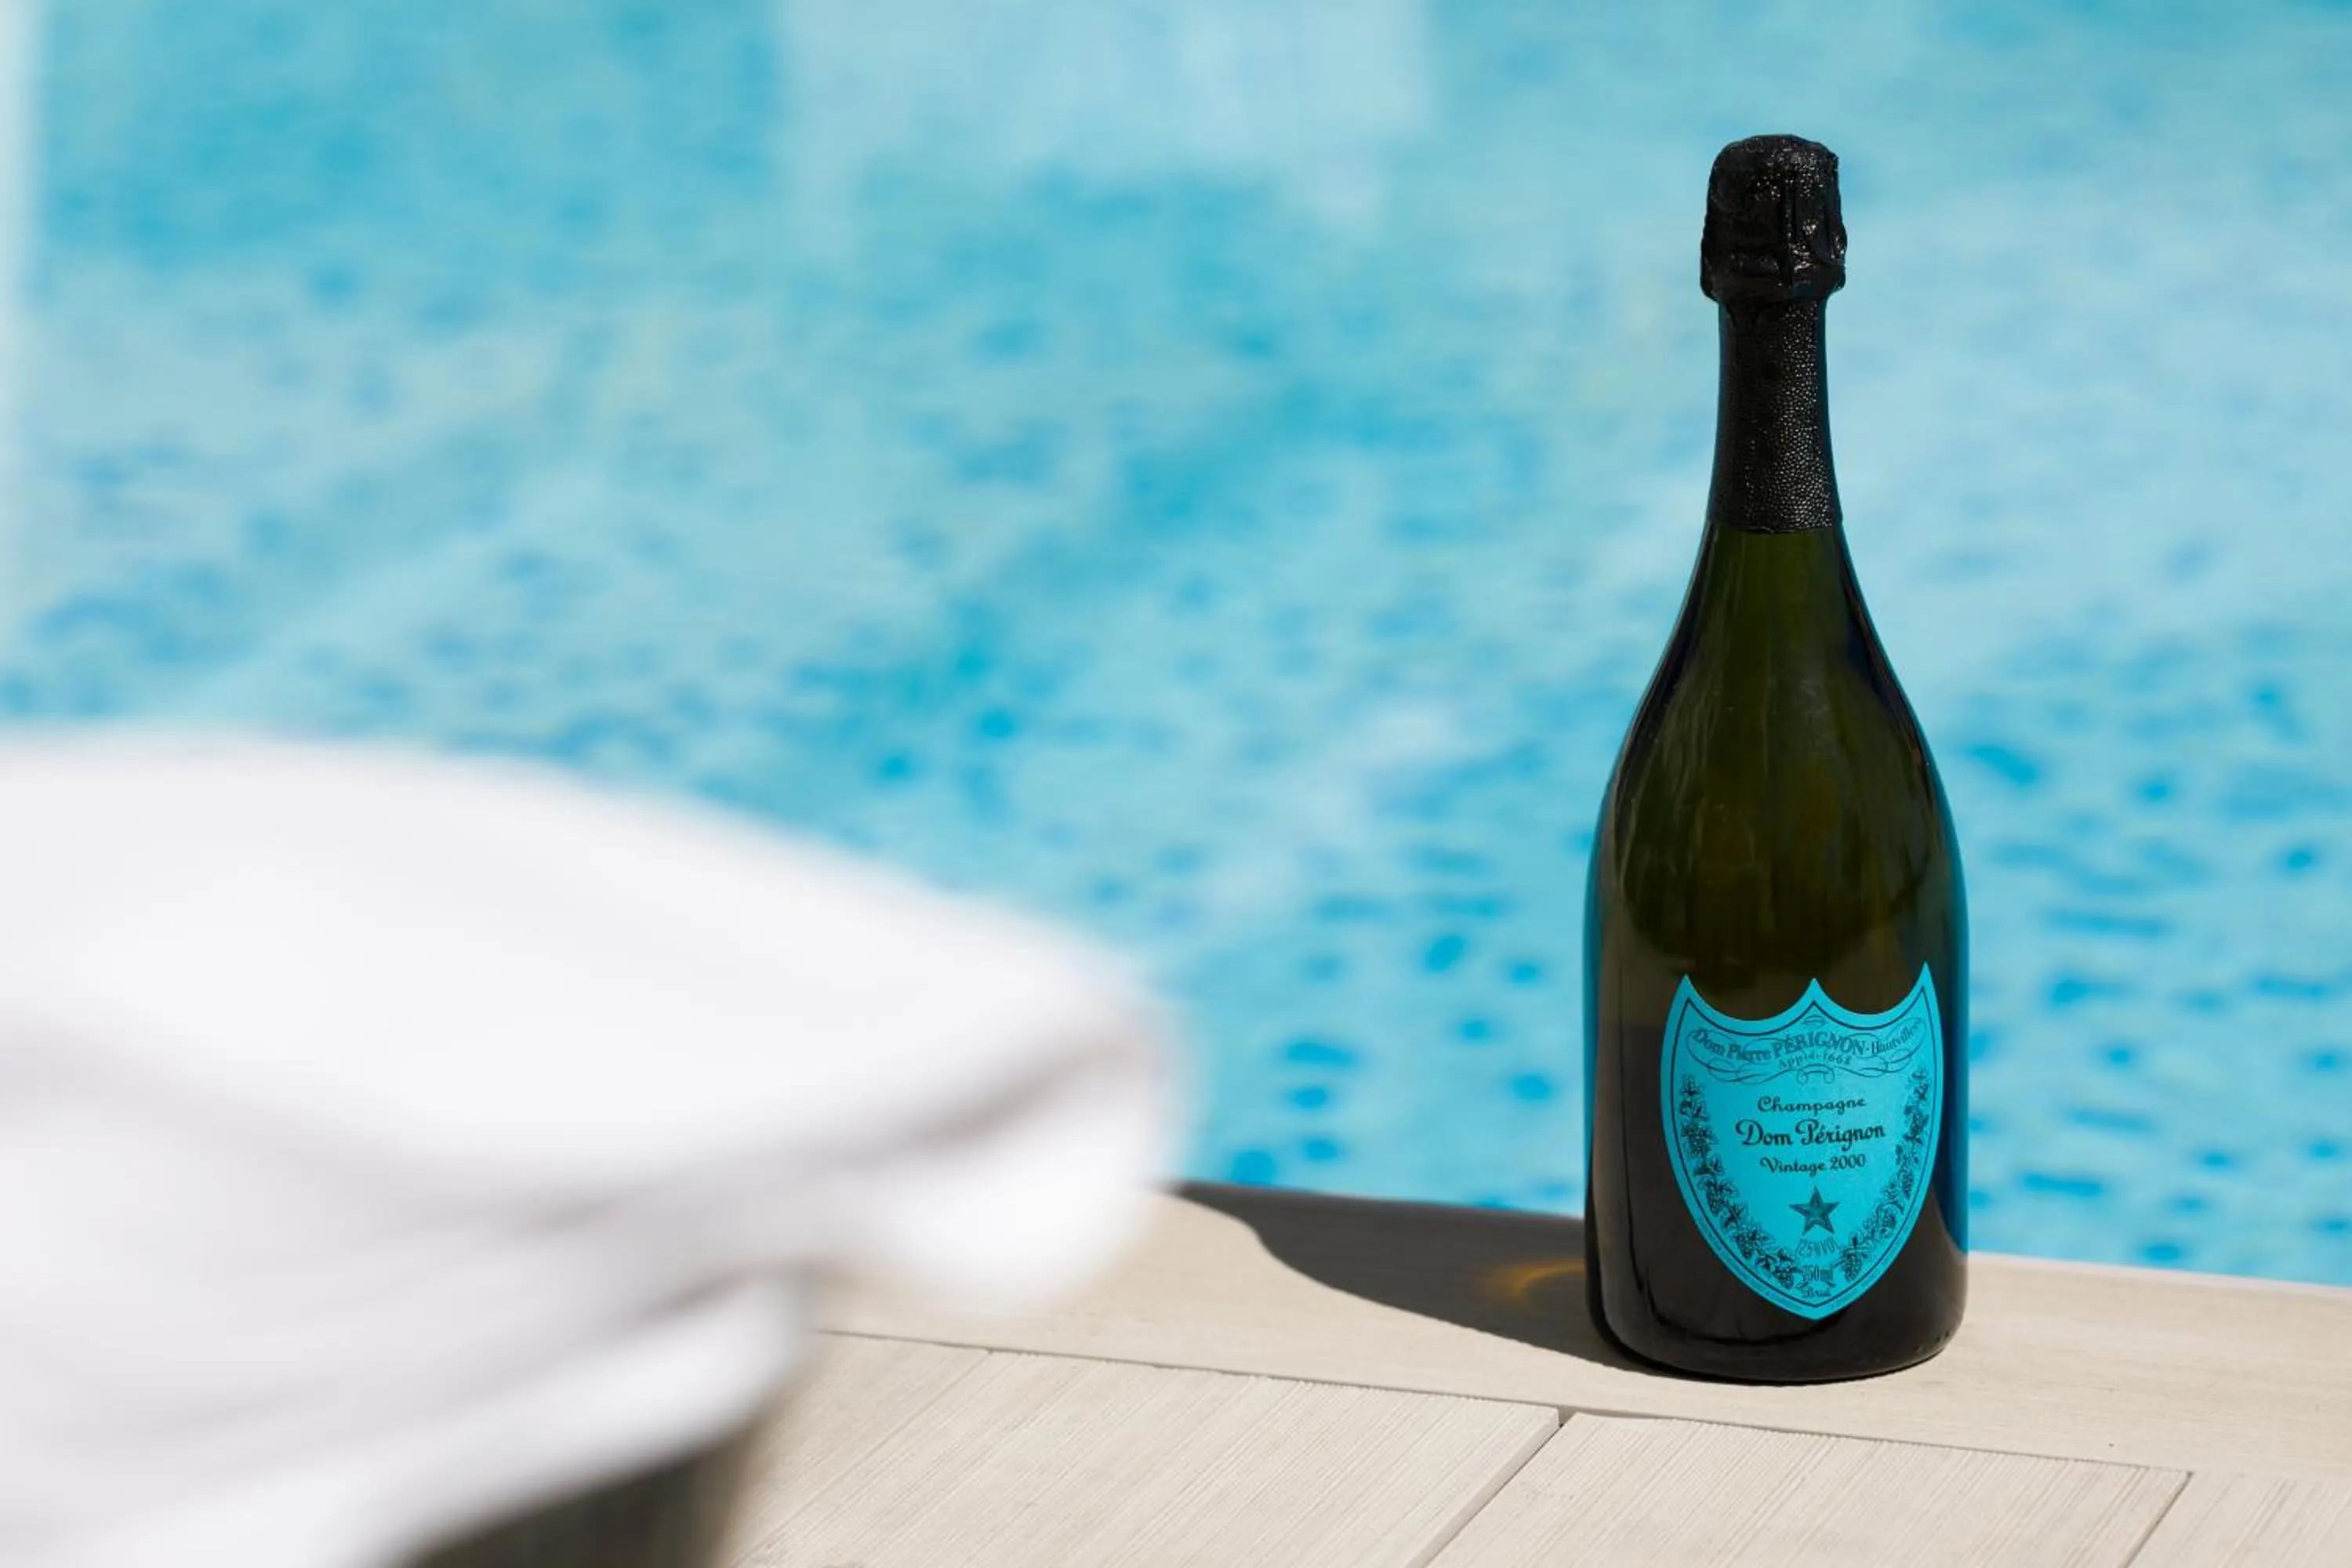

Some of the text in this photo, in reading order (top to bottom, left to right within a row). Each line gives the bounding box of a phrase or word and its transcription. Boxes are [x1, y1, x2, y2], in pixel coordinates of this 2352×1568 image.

[1693, 1029, 1726, 1056] Dom
[1726, 1044, 1771, 1064] Pierre
[1757, 1096, 1867, 1116] Champagne
[1735, 1119, 1886, 1152] Dom Pérignon
[1760, 1153, 1866, 1176] Vintage 2000
